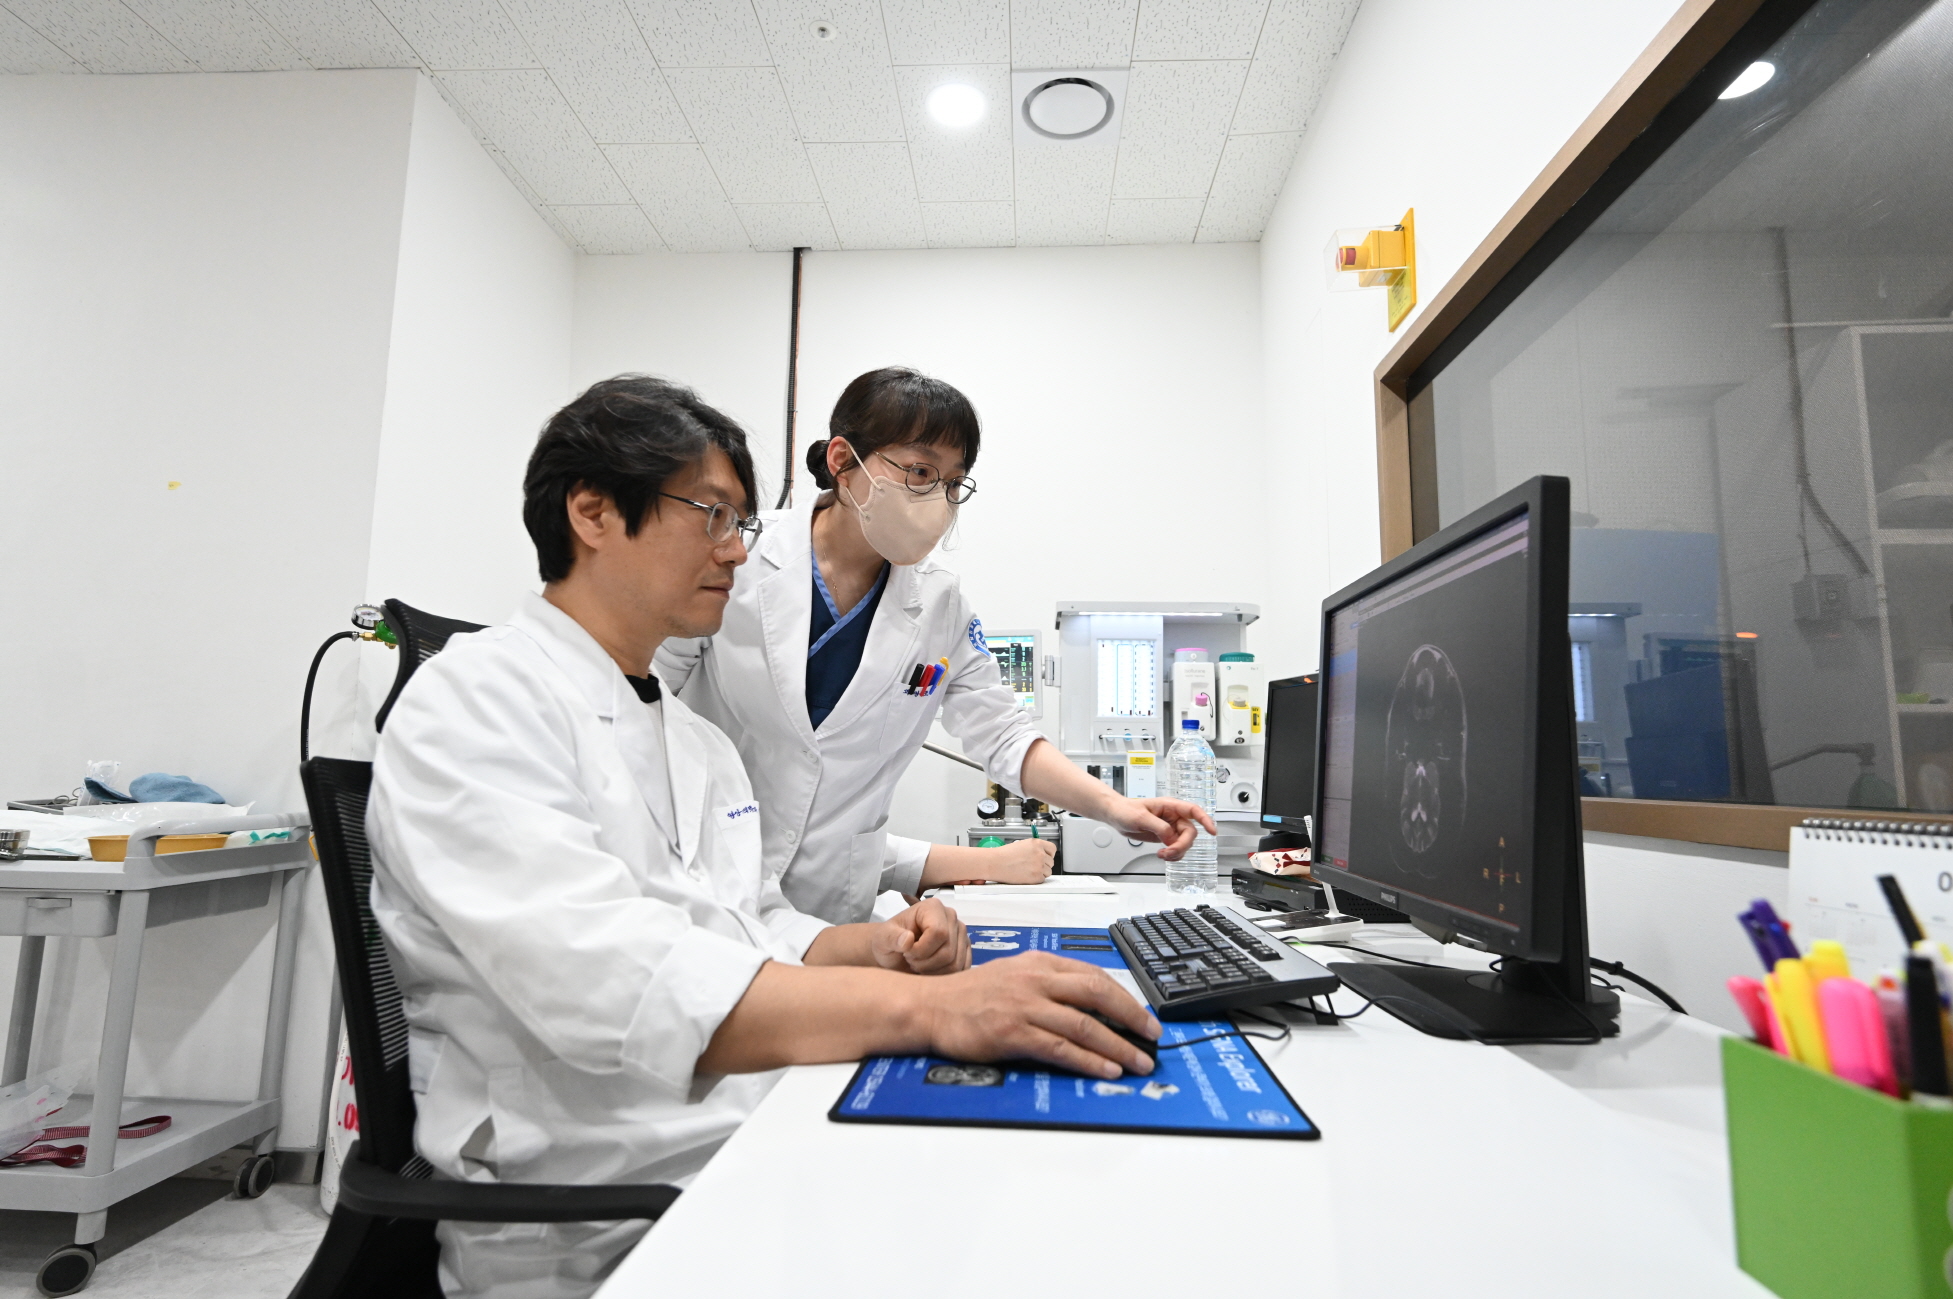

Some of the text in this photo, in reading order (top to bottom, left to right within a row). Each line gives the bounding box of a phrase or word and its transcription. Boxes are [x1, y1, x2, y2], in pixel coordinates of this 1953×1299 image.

[1498, 836, 1505, 848] A
[1483, 867, 1489, 879] R
[1515, 871, 1521, 884] L
[1498, 903, 1505, 913] P
